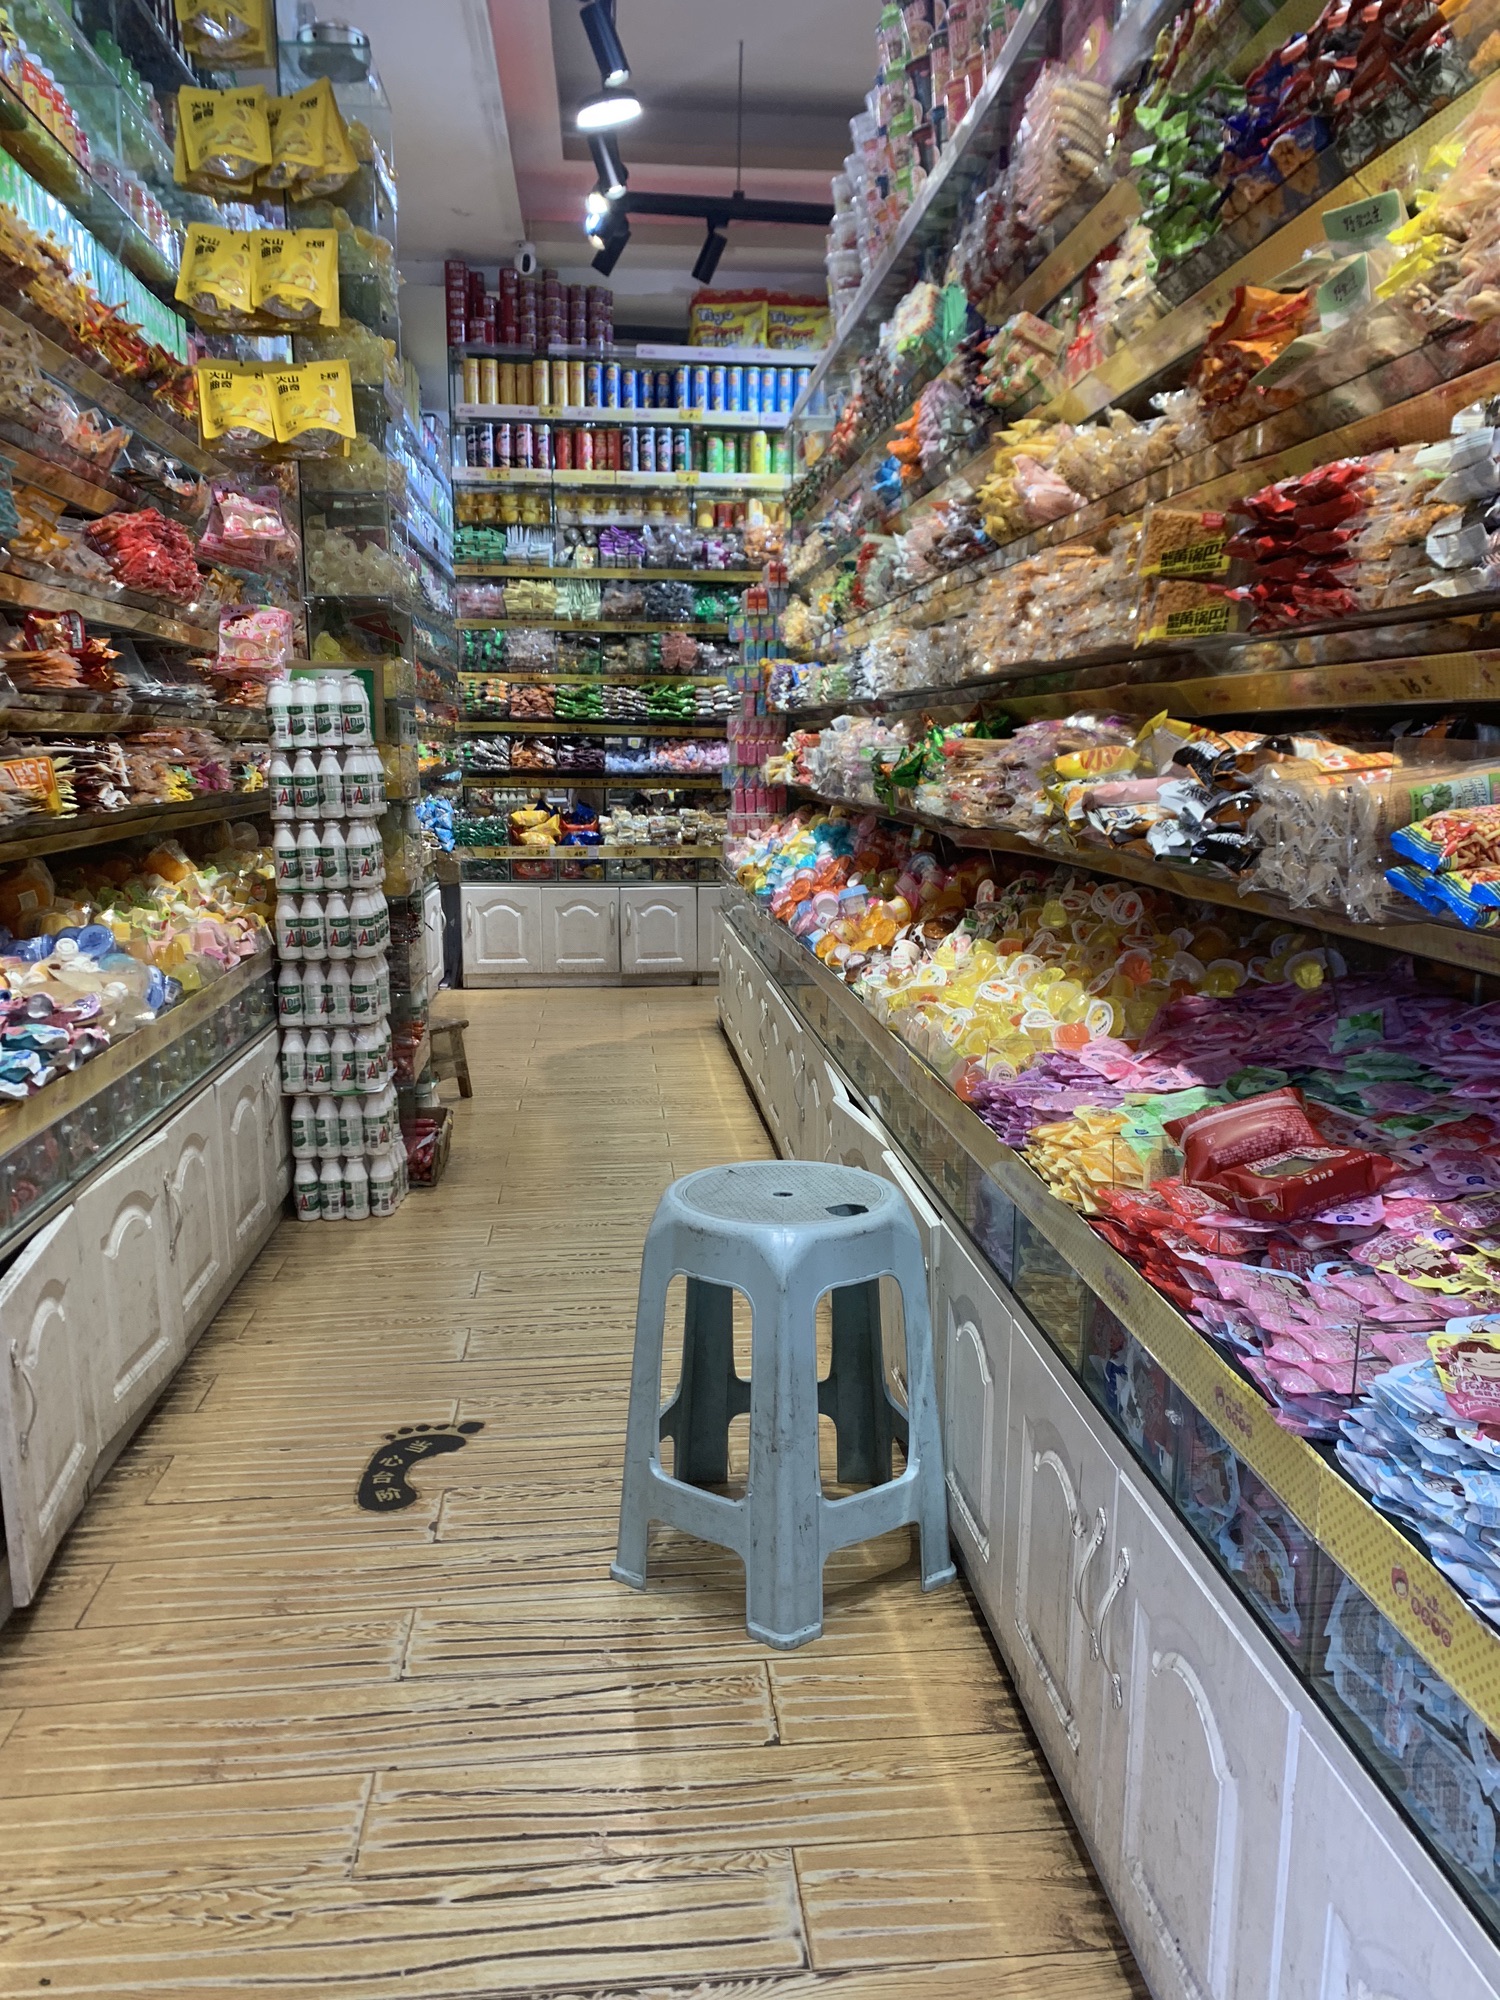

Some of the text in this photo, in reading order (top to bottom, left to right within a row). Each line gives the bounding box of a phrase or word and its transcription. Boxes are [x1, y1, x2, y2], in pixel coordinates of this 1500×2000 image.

[190, 101, 214, 112] 火山
[197, 234, 220, 246] 火山
[260, 237, 284, 246] 火山
[209, 371, 233, 380] 火山
[276, 374, 300, 384] 火山
[371, 1439, 433, 1503] 当心台阶
